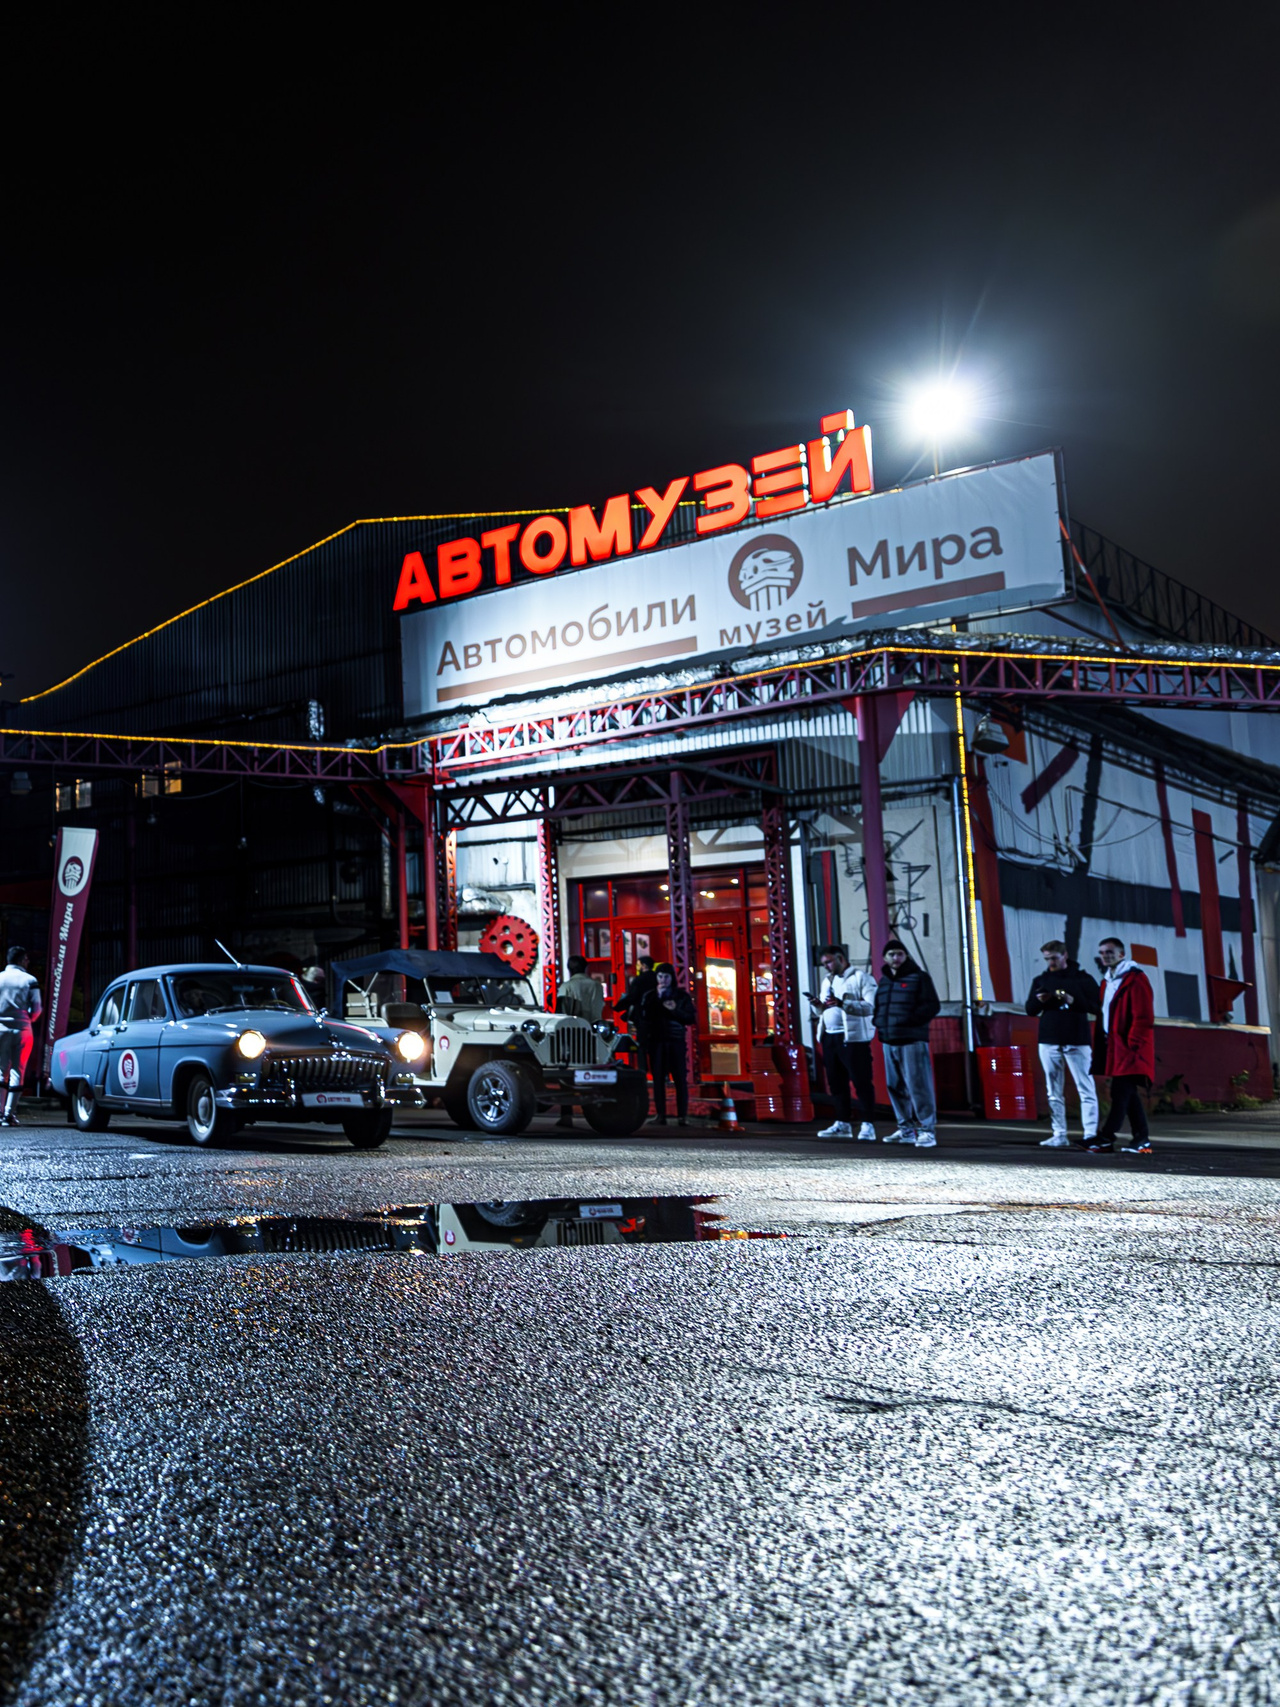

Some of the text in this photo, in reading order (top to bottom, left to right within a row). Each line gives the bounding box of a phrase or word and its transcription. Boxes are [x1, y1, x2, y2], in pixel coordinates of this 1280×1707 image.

[393, 409, 873, 610] АВТОМУЗЕЙ
[437, 526, 1003, 676] Автомобили Мира
[718, 604, 827, 648] музей
[49, 902, 74, 1040] Автомобили Мира
